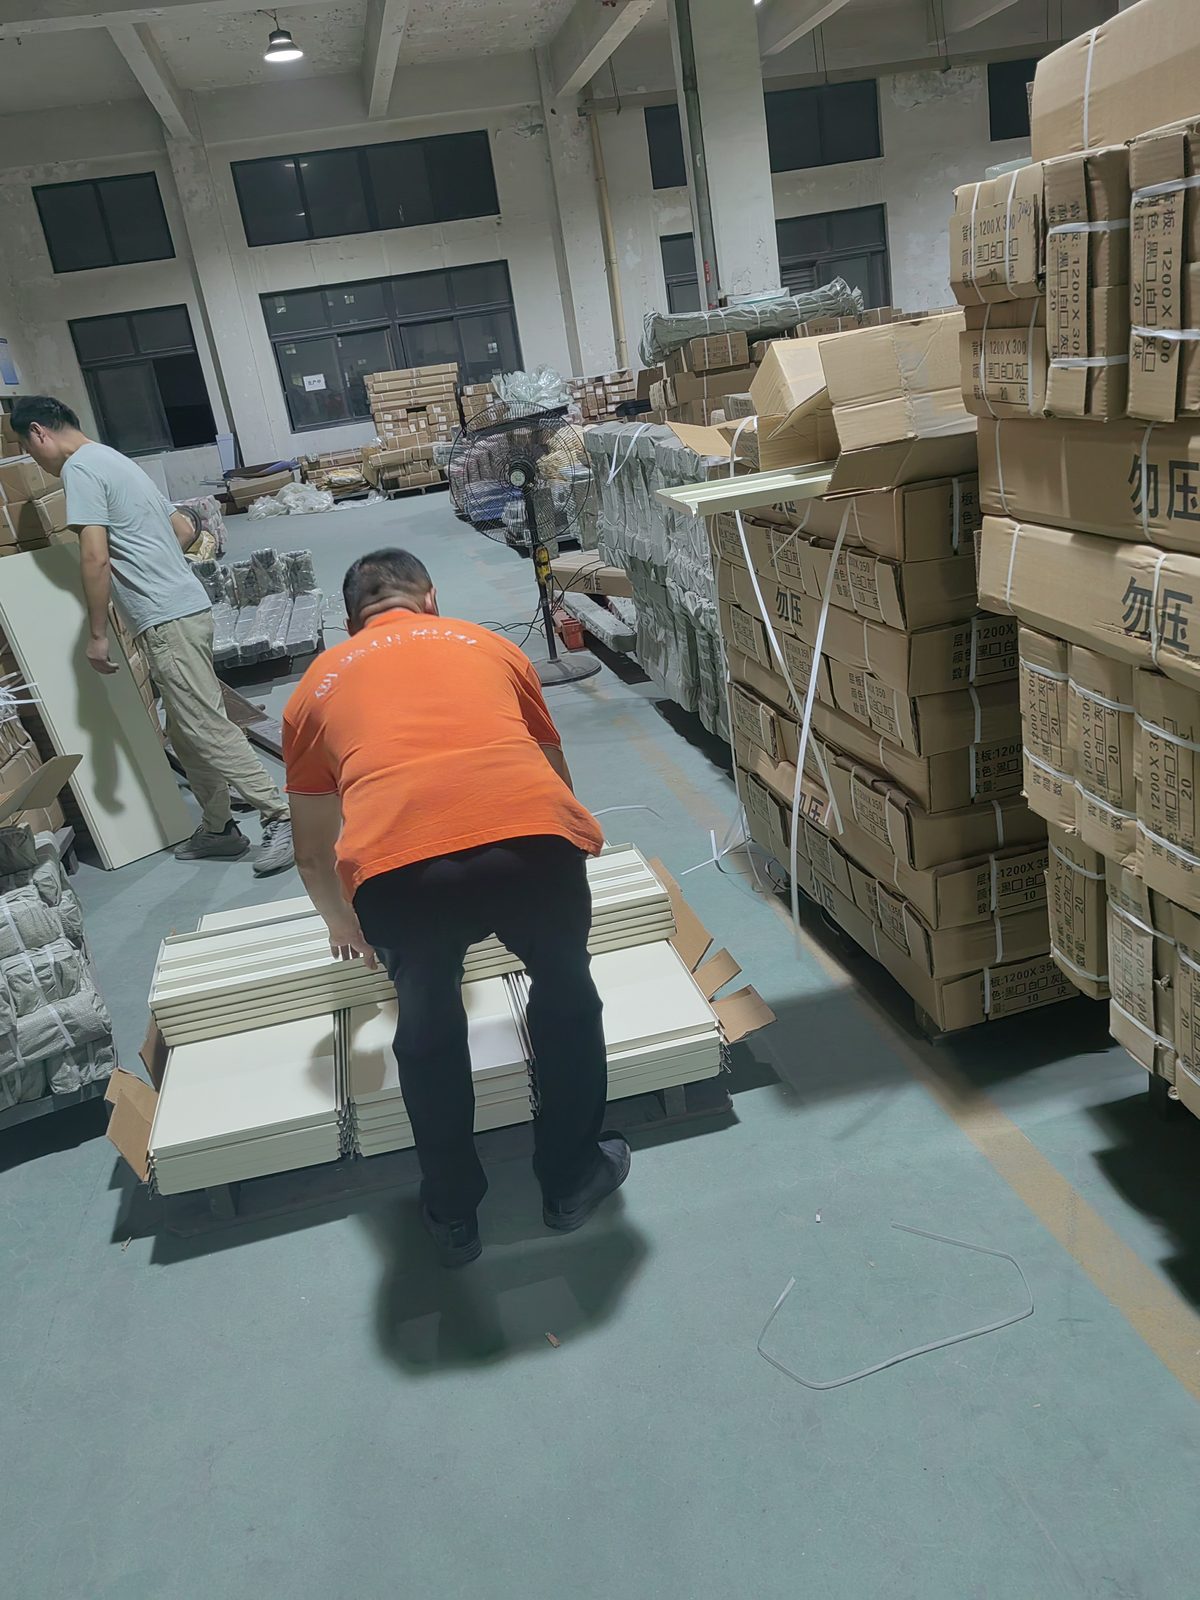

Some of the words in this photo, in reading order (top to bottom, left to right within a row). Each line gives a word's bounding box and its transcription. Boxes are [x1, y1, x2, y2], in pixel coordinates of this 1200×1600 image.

[1072, 257, 1080, 303] 1200
[1162, 247, 1172, 298] 1200
[1050, 290, 1057, 311] 20
[1134, 283, 1142, 306] 20
[1162, 304, 1173, 318] X
[1013, 338, 1027, 355] 300
[1128, 454, 1200, 521] 勿压
[1121, 576, 1193, 652] 勿压
[977, 624, 1014, 639] 1200X
[1002, 656, 1015, 668] 10
[1051, 718, 1059, 735] 20
[1108, 745, 1118, 765] 20
[1149, 756, 1160, 769] X
[1151, 772, 1160, 810] 1200
[1181, 778, 1192, 801] 20
[1001, 862, 1034, 878] 1200X
[1025, 890, 1036, 901] 10
[1075, 897, 1084, 914] 20
[1005, 968, 1036, 983] 1200X
[1028, 994, 1038, 1003] 10
